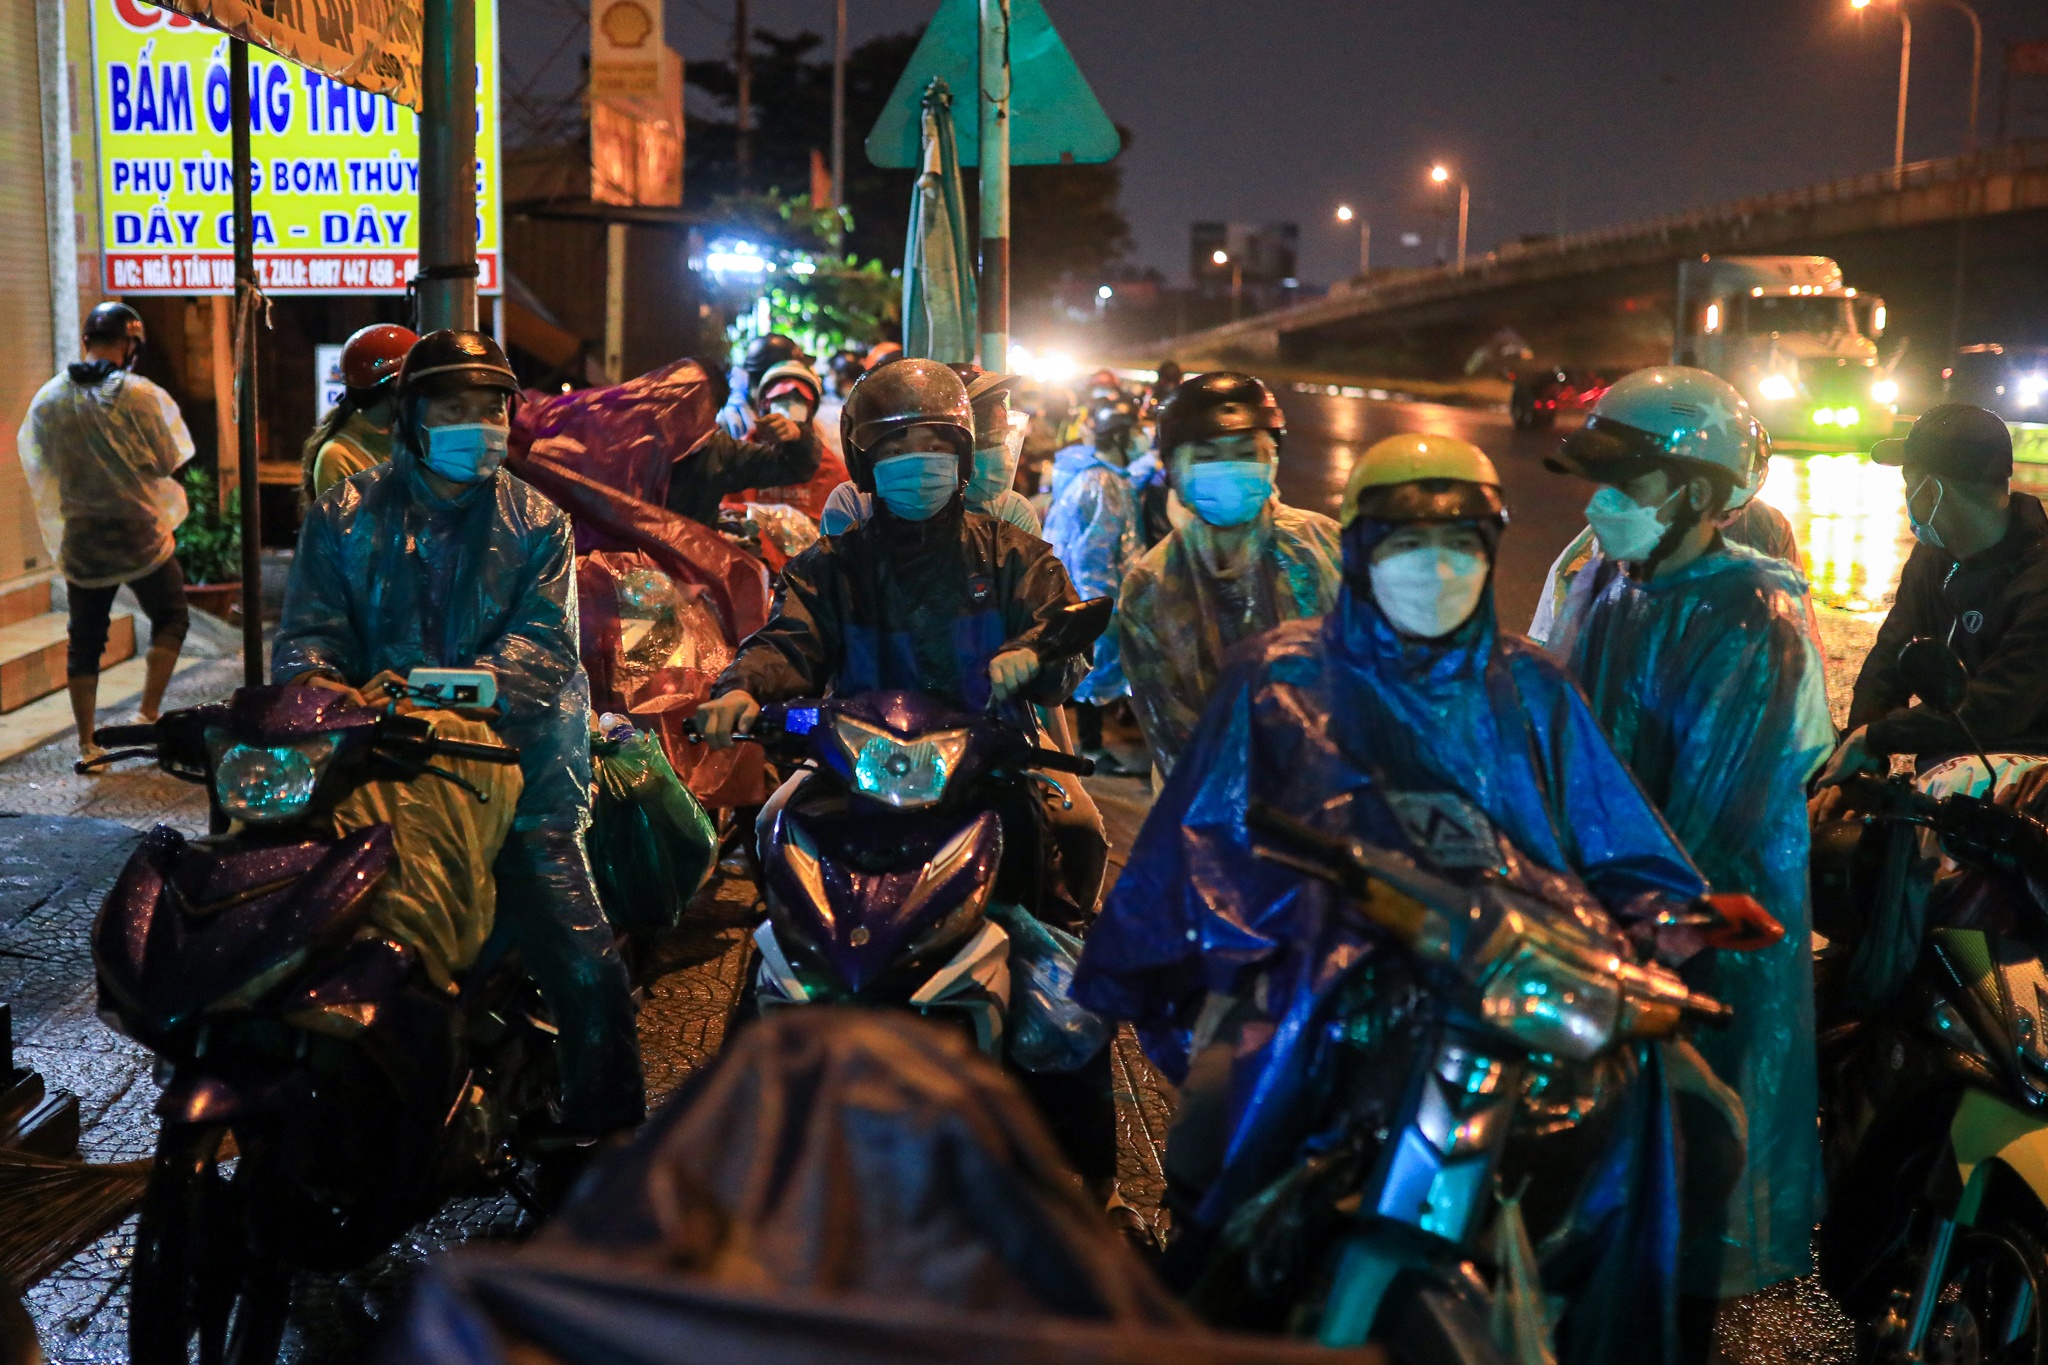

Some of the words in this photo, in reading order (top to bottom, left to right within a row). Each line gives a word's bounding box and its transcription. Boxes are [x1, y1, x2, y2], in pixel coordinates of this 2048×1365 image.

[111, 40, 193, 131] BẤM
[114, 162, 171, 200] PHỤ
[275, 161, 338, 191] BƠM
[116, 206, 199, 243] DÂY
[324, 207, 407, 243] DÂY
[173, 259, 183, 287] 3
